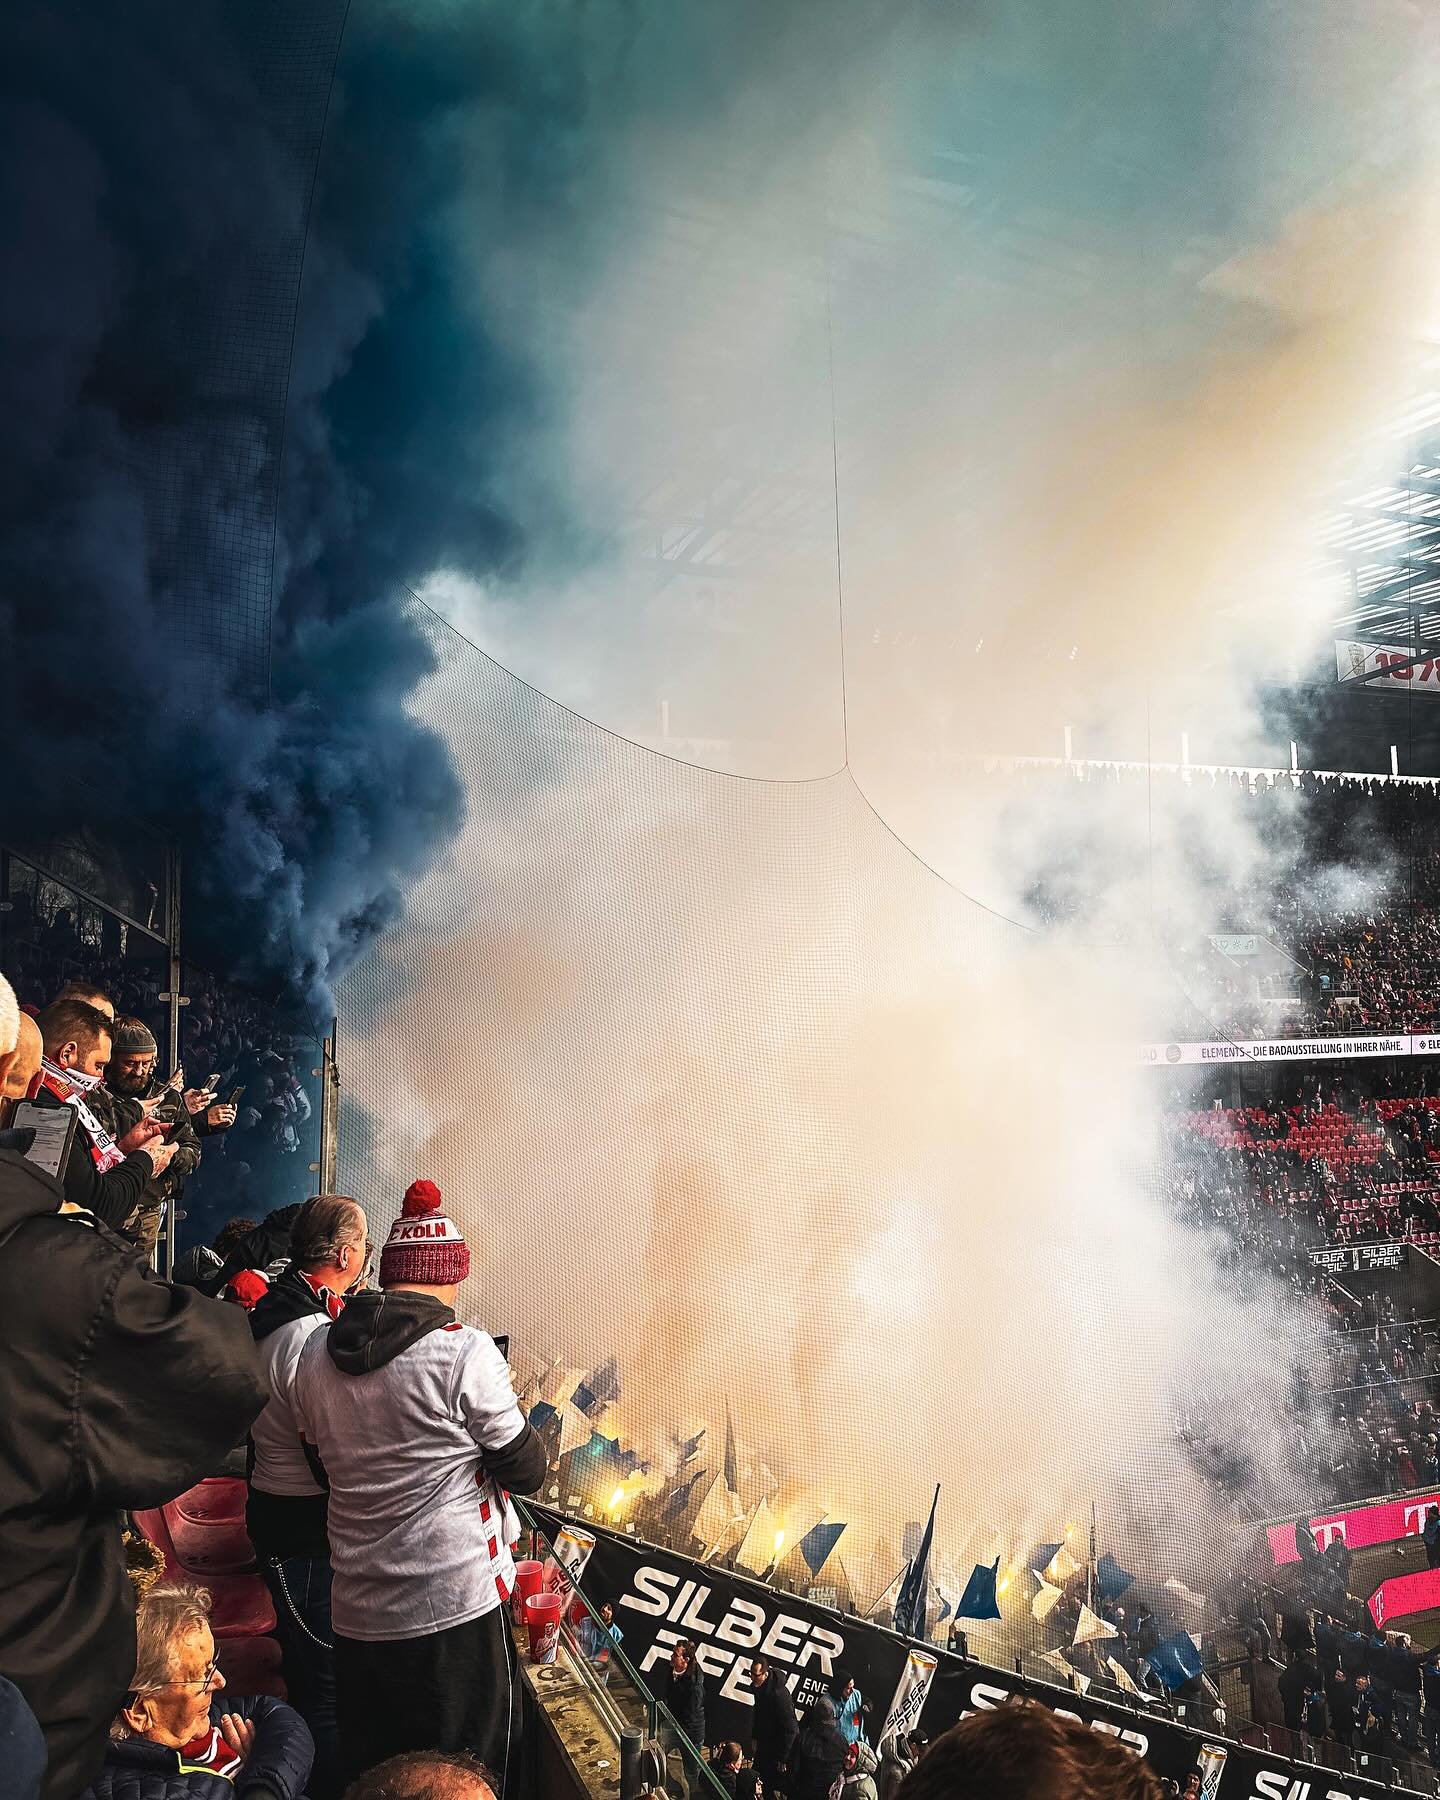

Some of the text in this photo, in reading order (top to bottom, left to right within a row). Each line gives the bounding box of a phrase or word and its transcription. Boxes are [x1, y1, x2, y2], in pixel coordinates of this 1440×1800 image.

[1201, 1046, 1245, 1059] ELEMENTS
[1253, 1046, 1267, 1057] DIE
[1269, 1043, 1342, 1056] BADAUSSTELLUNG
[1344, 1043, 1352, 1053] IN
[1354, 1042, 1378, 1053] IHRER
[1379, 1040, 1404, 1052] NÄHE.
[1362, 1246, 1401, 1259] SILBER
[1370, 1256, 1399, 1268] PFEIL
[619, 1566, 845, 1677] SILBER
[803, 1677, 829, 1695] ENE
[887, 1680, 926, 1730] SILBER
[896, 1693, 928, 1732] PFEIL
